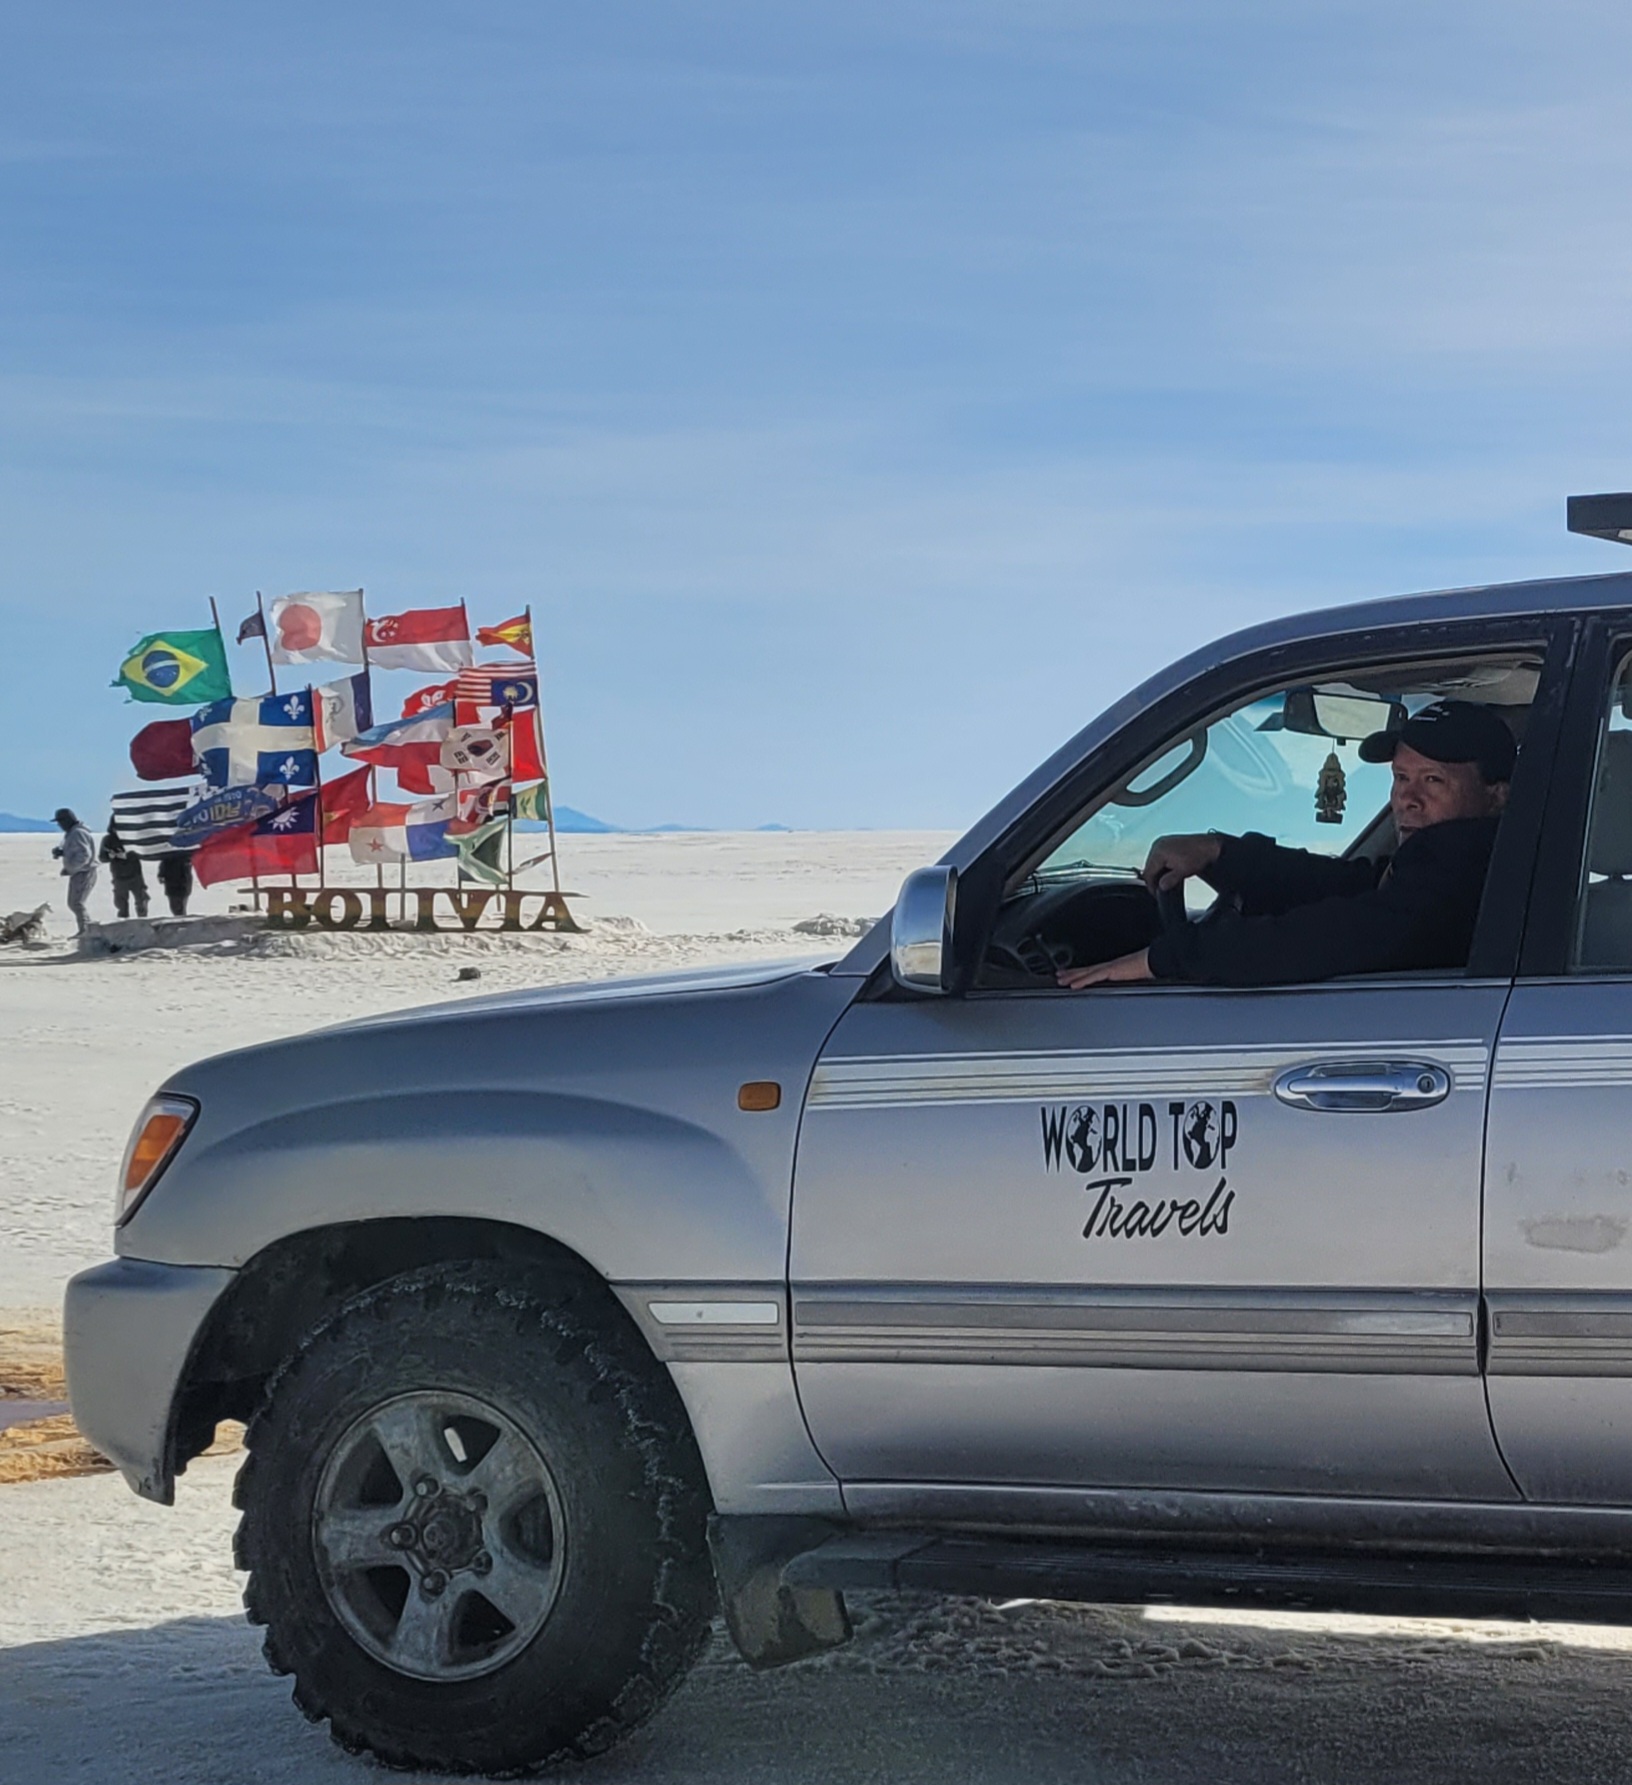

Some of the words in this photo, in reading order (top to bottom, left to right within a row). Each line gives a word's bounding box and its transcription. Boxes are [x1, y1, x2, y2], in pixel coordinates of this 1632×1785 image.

[265, 888, 590, 932] BOLIVIA
[1041, 1103, 1157, 1173] WORLD
[1168, 1100, 1238, 1170] TOP
[1082, 1176, 1236, 1239] Travels
